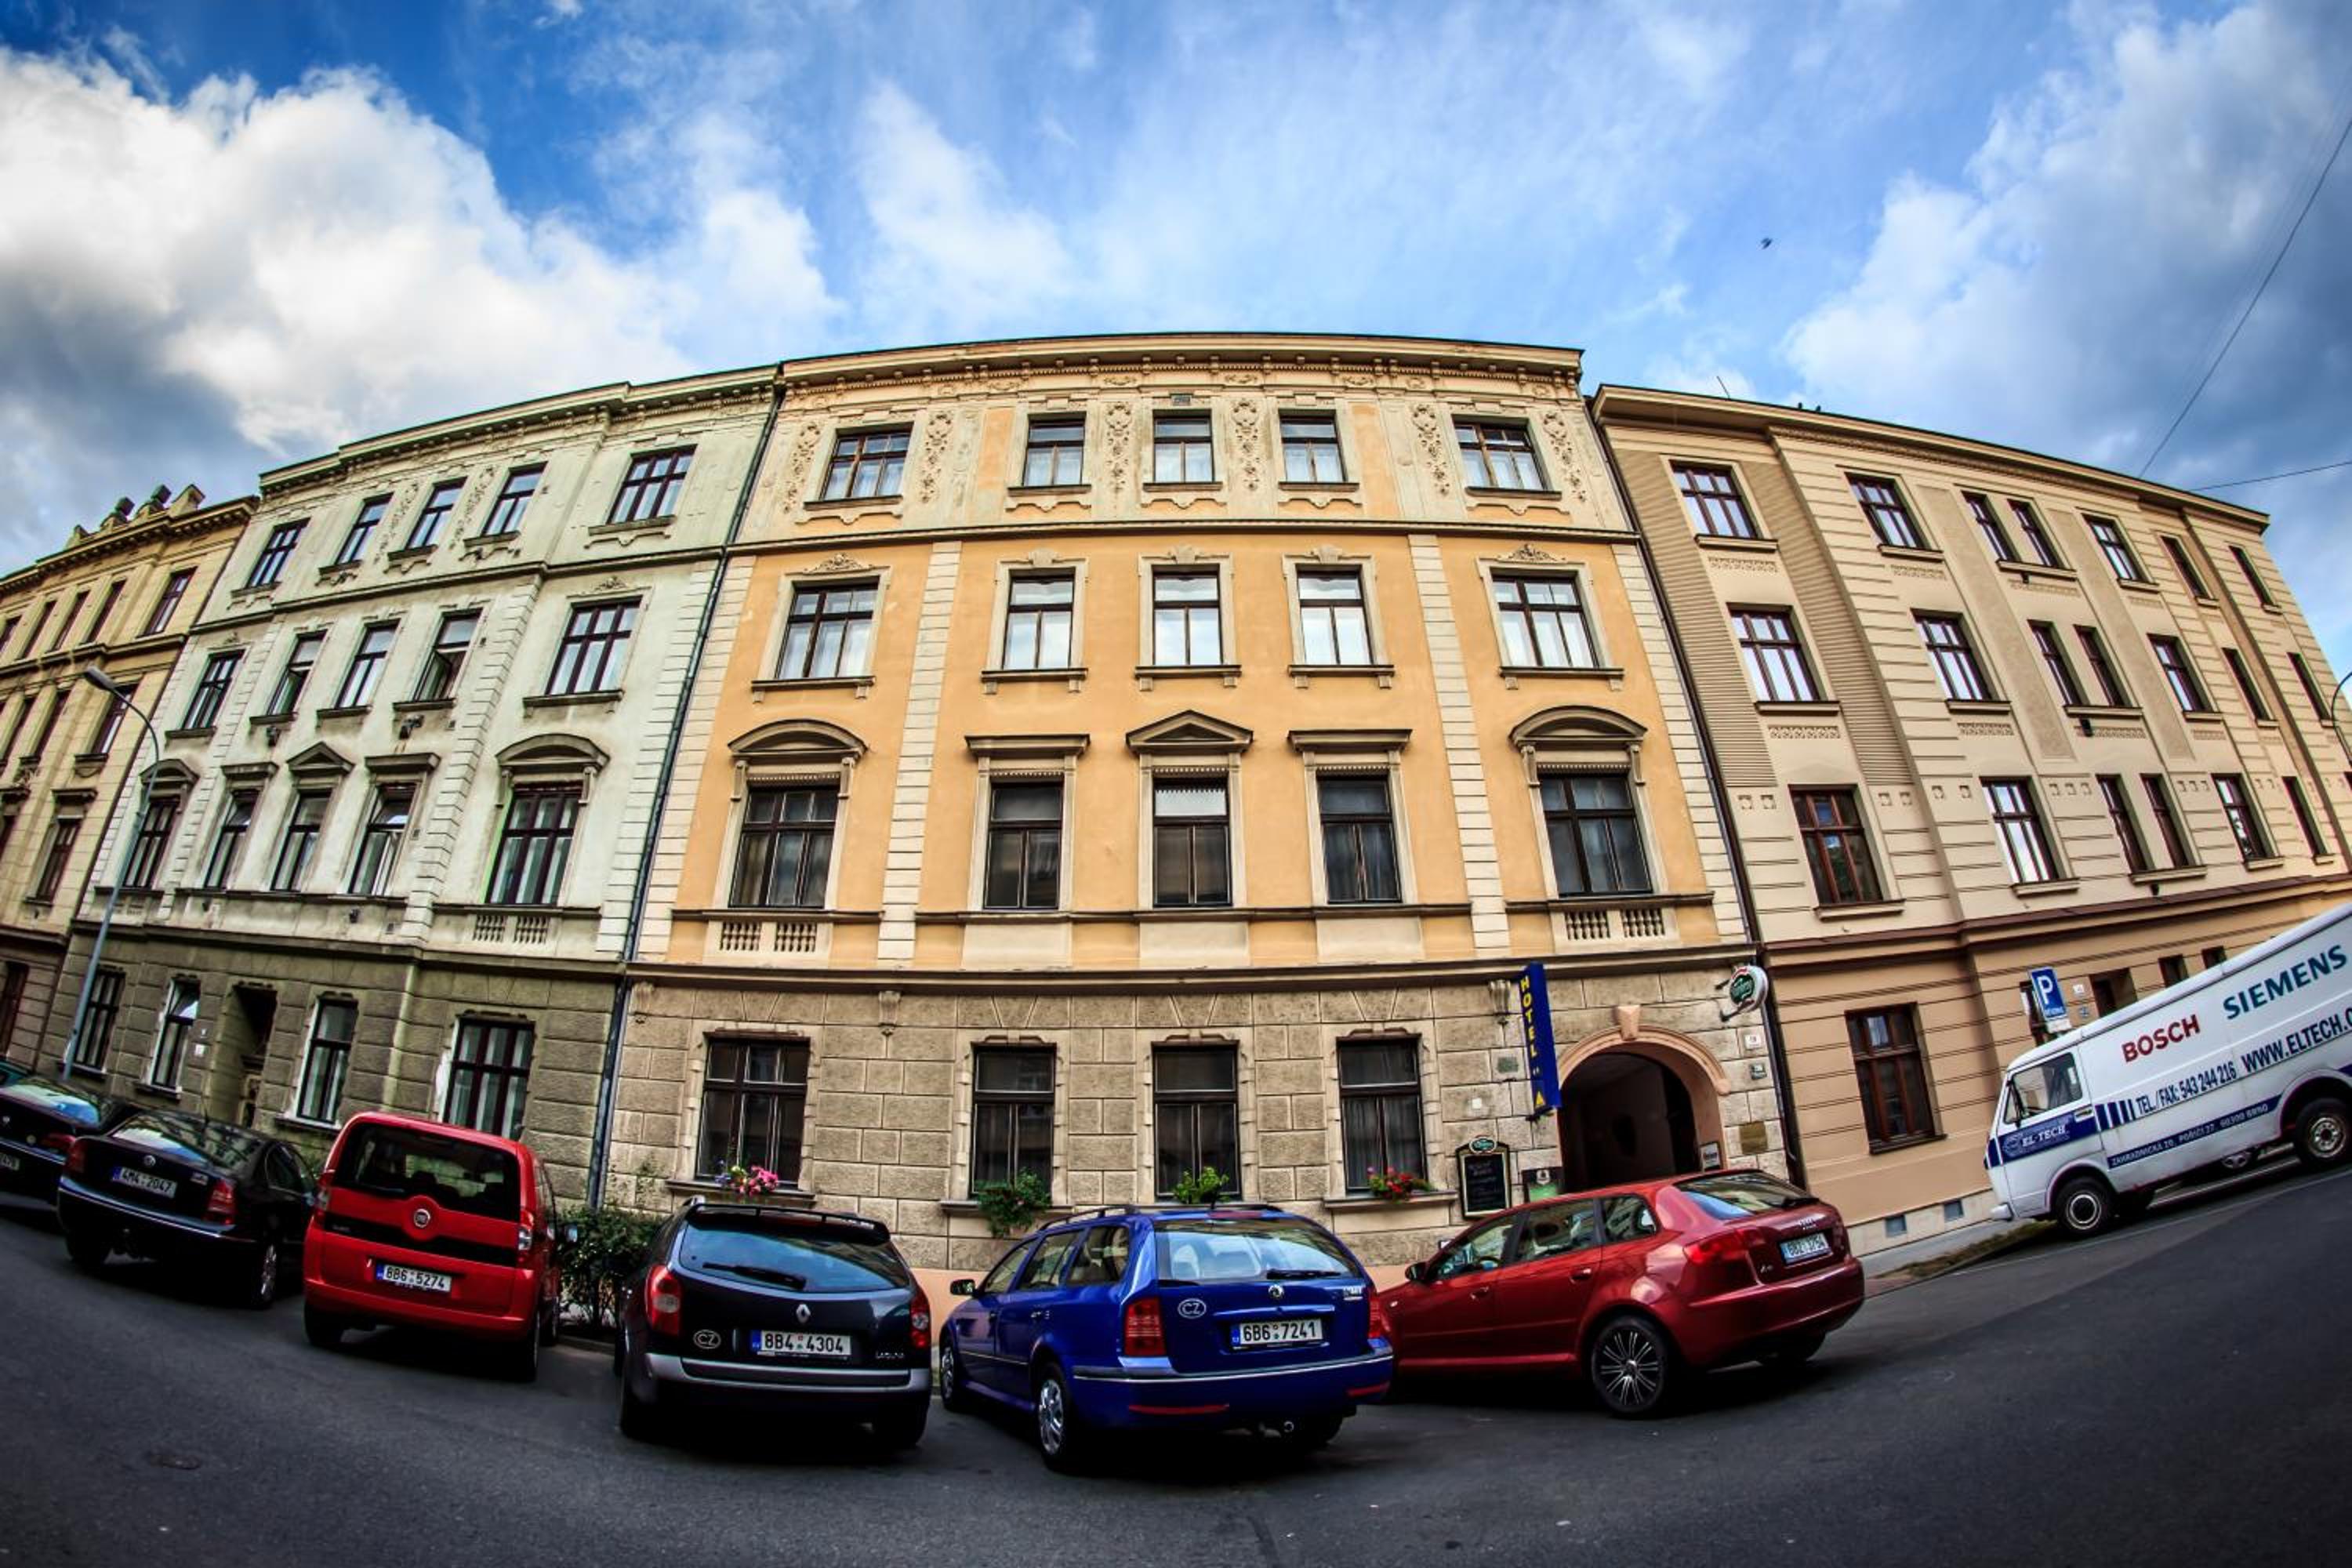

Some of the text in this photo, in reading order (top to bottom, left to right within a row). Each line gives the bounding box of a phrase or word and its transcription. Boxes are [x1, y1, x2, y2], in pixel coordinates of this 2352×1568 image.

[2038, 975, 2053, 1005] P
[2223, 945, 2347, 1020] SIEMENS
[1520, 975, 1537, 1058] HOTEL
[2122, 1014, 2201, 1063] BOSCH
[2180, 1076, 2198, 1098] 543
[2198, 1068, 2218, 1091] 244
[2217, 1061, 2237, 1083] 216
[416, 1272, 445, 1289] 5274
[1181, 1302, 1202, 1315] CZ
[697, 1333, 717, 1346] CZ
[764, 1333, 844, 1353] 8B4 4304
[1243, 1322, 1316, 1341] 6B6 7241
